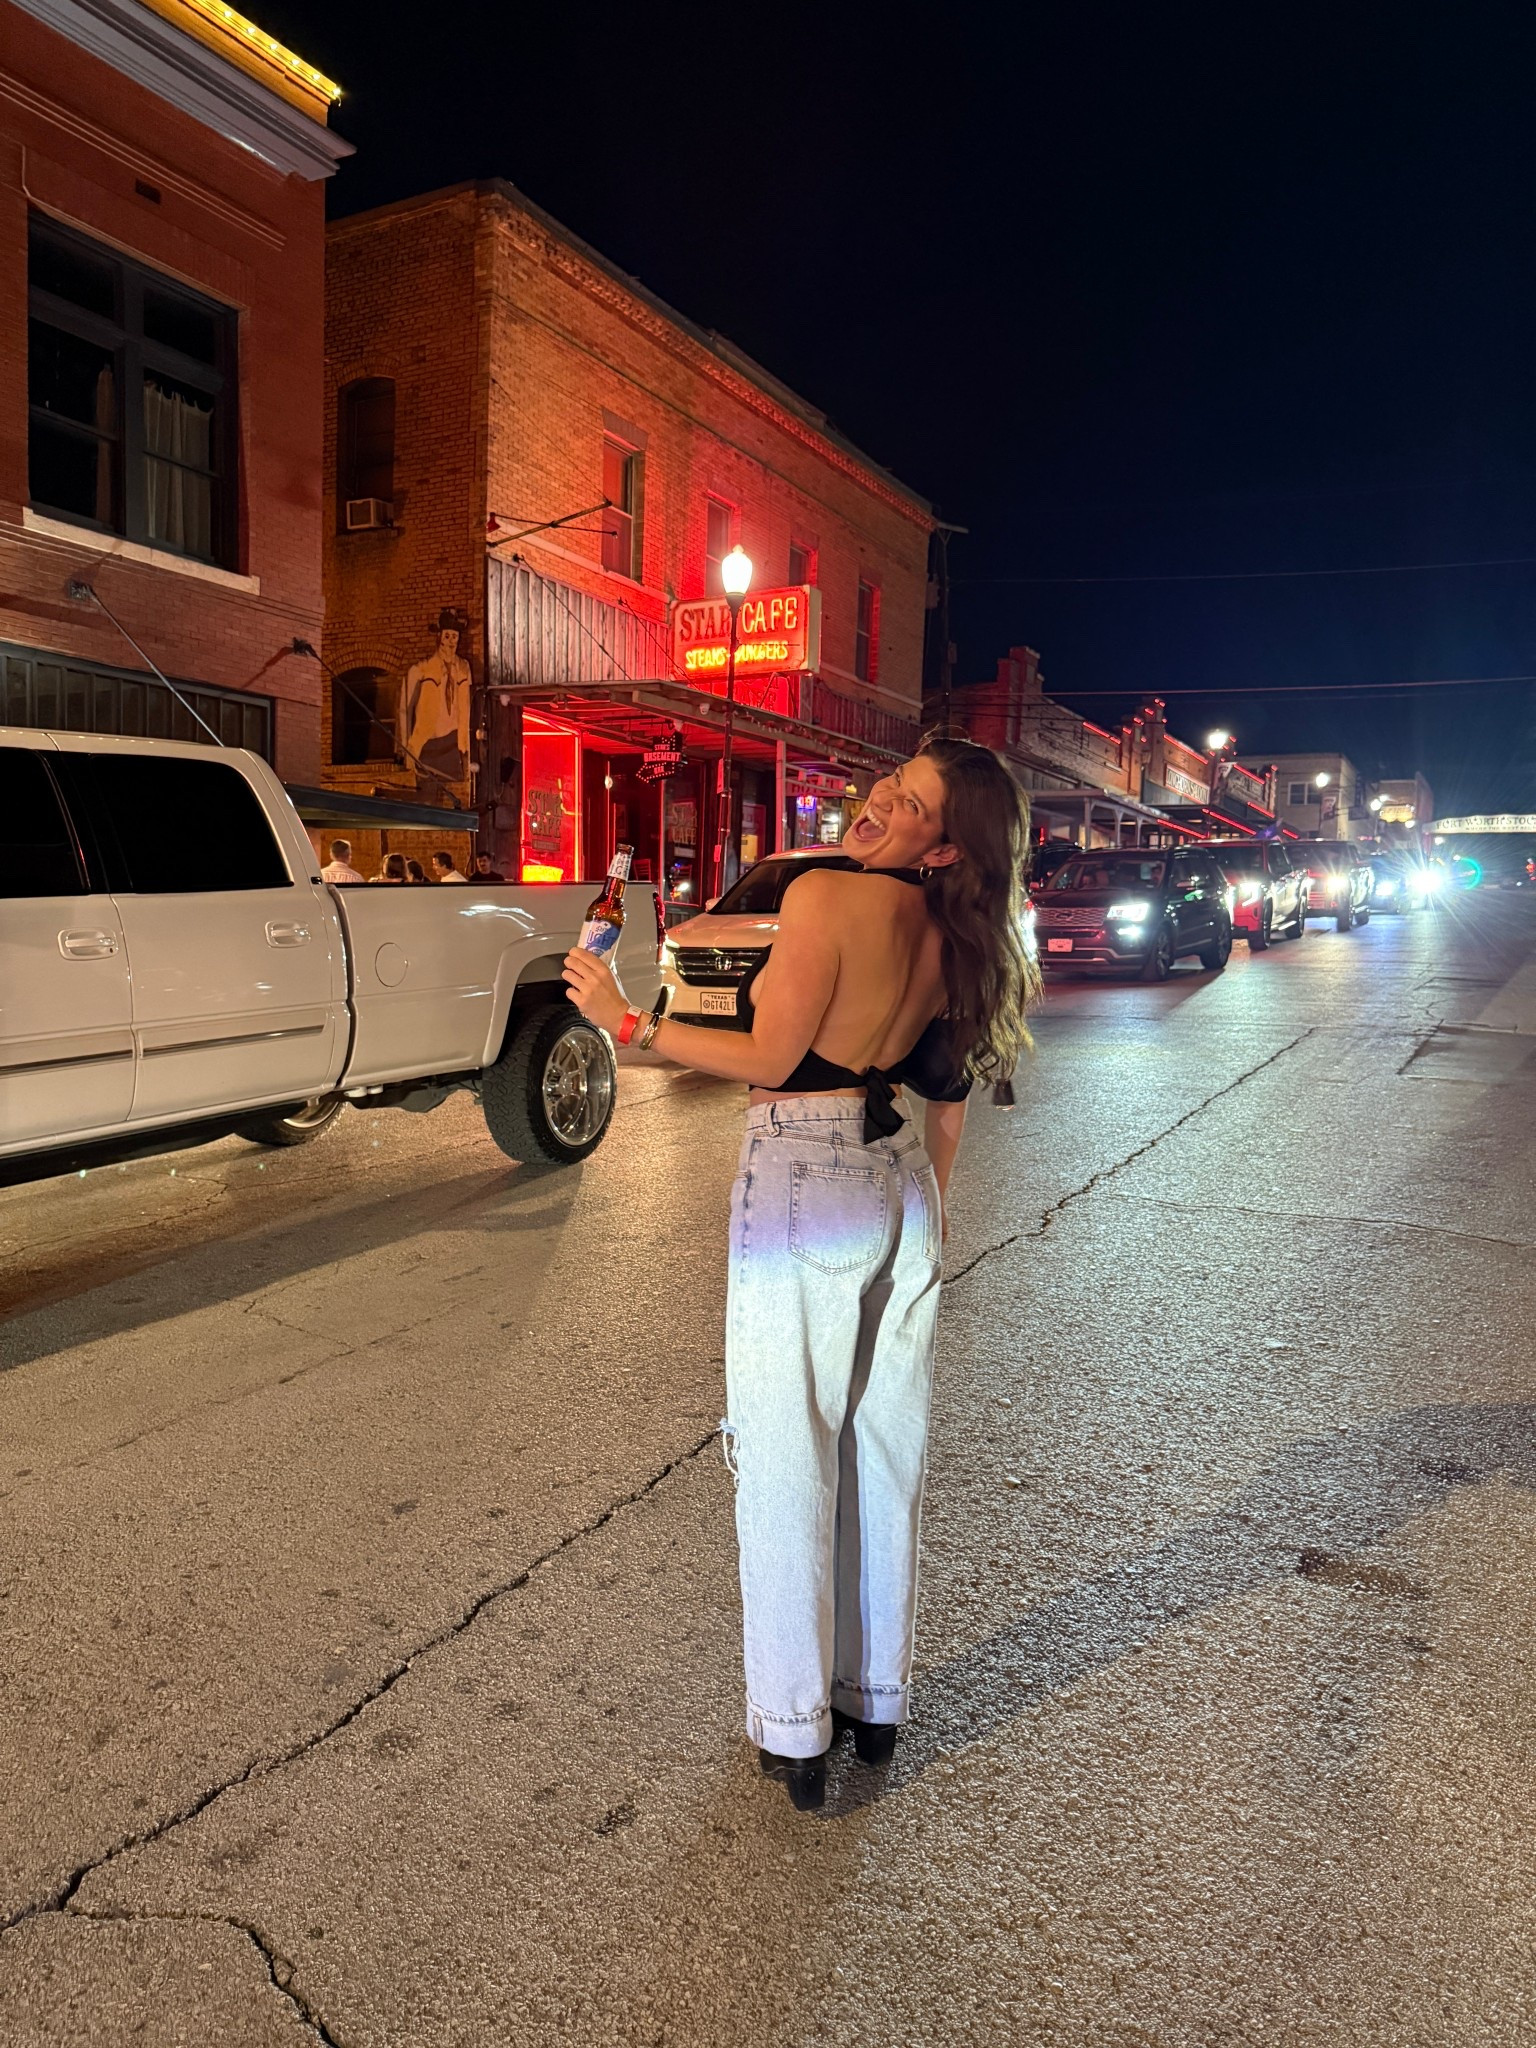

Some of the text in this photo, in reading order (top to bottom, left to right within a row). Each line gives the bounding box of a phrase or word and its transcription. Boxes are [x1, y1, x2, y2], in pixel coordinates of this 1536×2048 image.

[741, 596, 798, 633] CAFE
[644, 752, 681, 762] BASEMENT
[1436, 820, 1463, 829] FORT
[1465, 817, 1505, 826] WORTH
